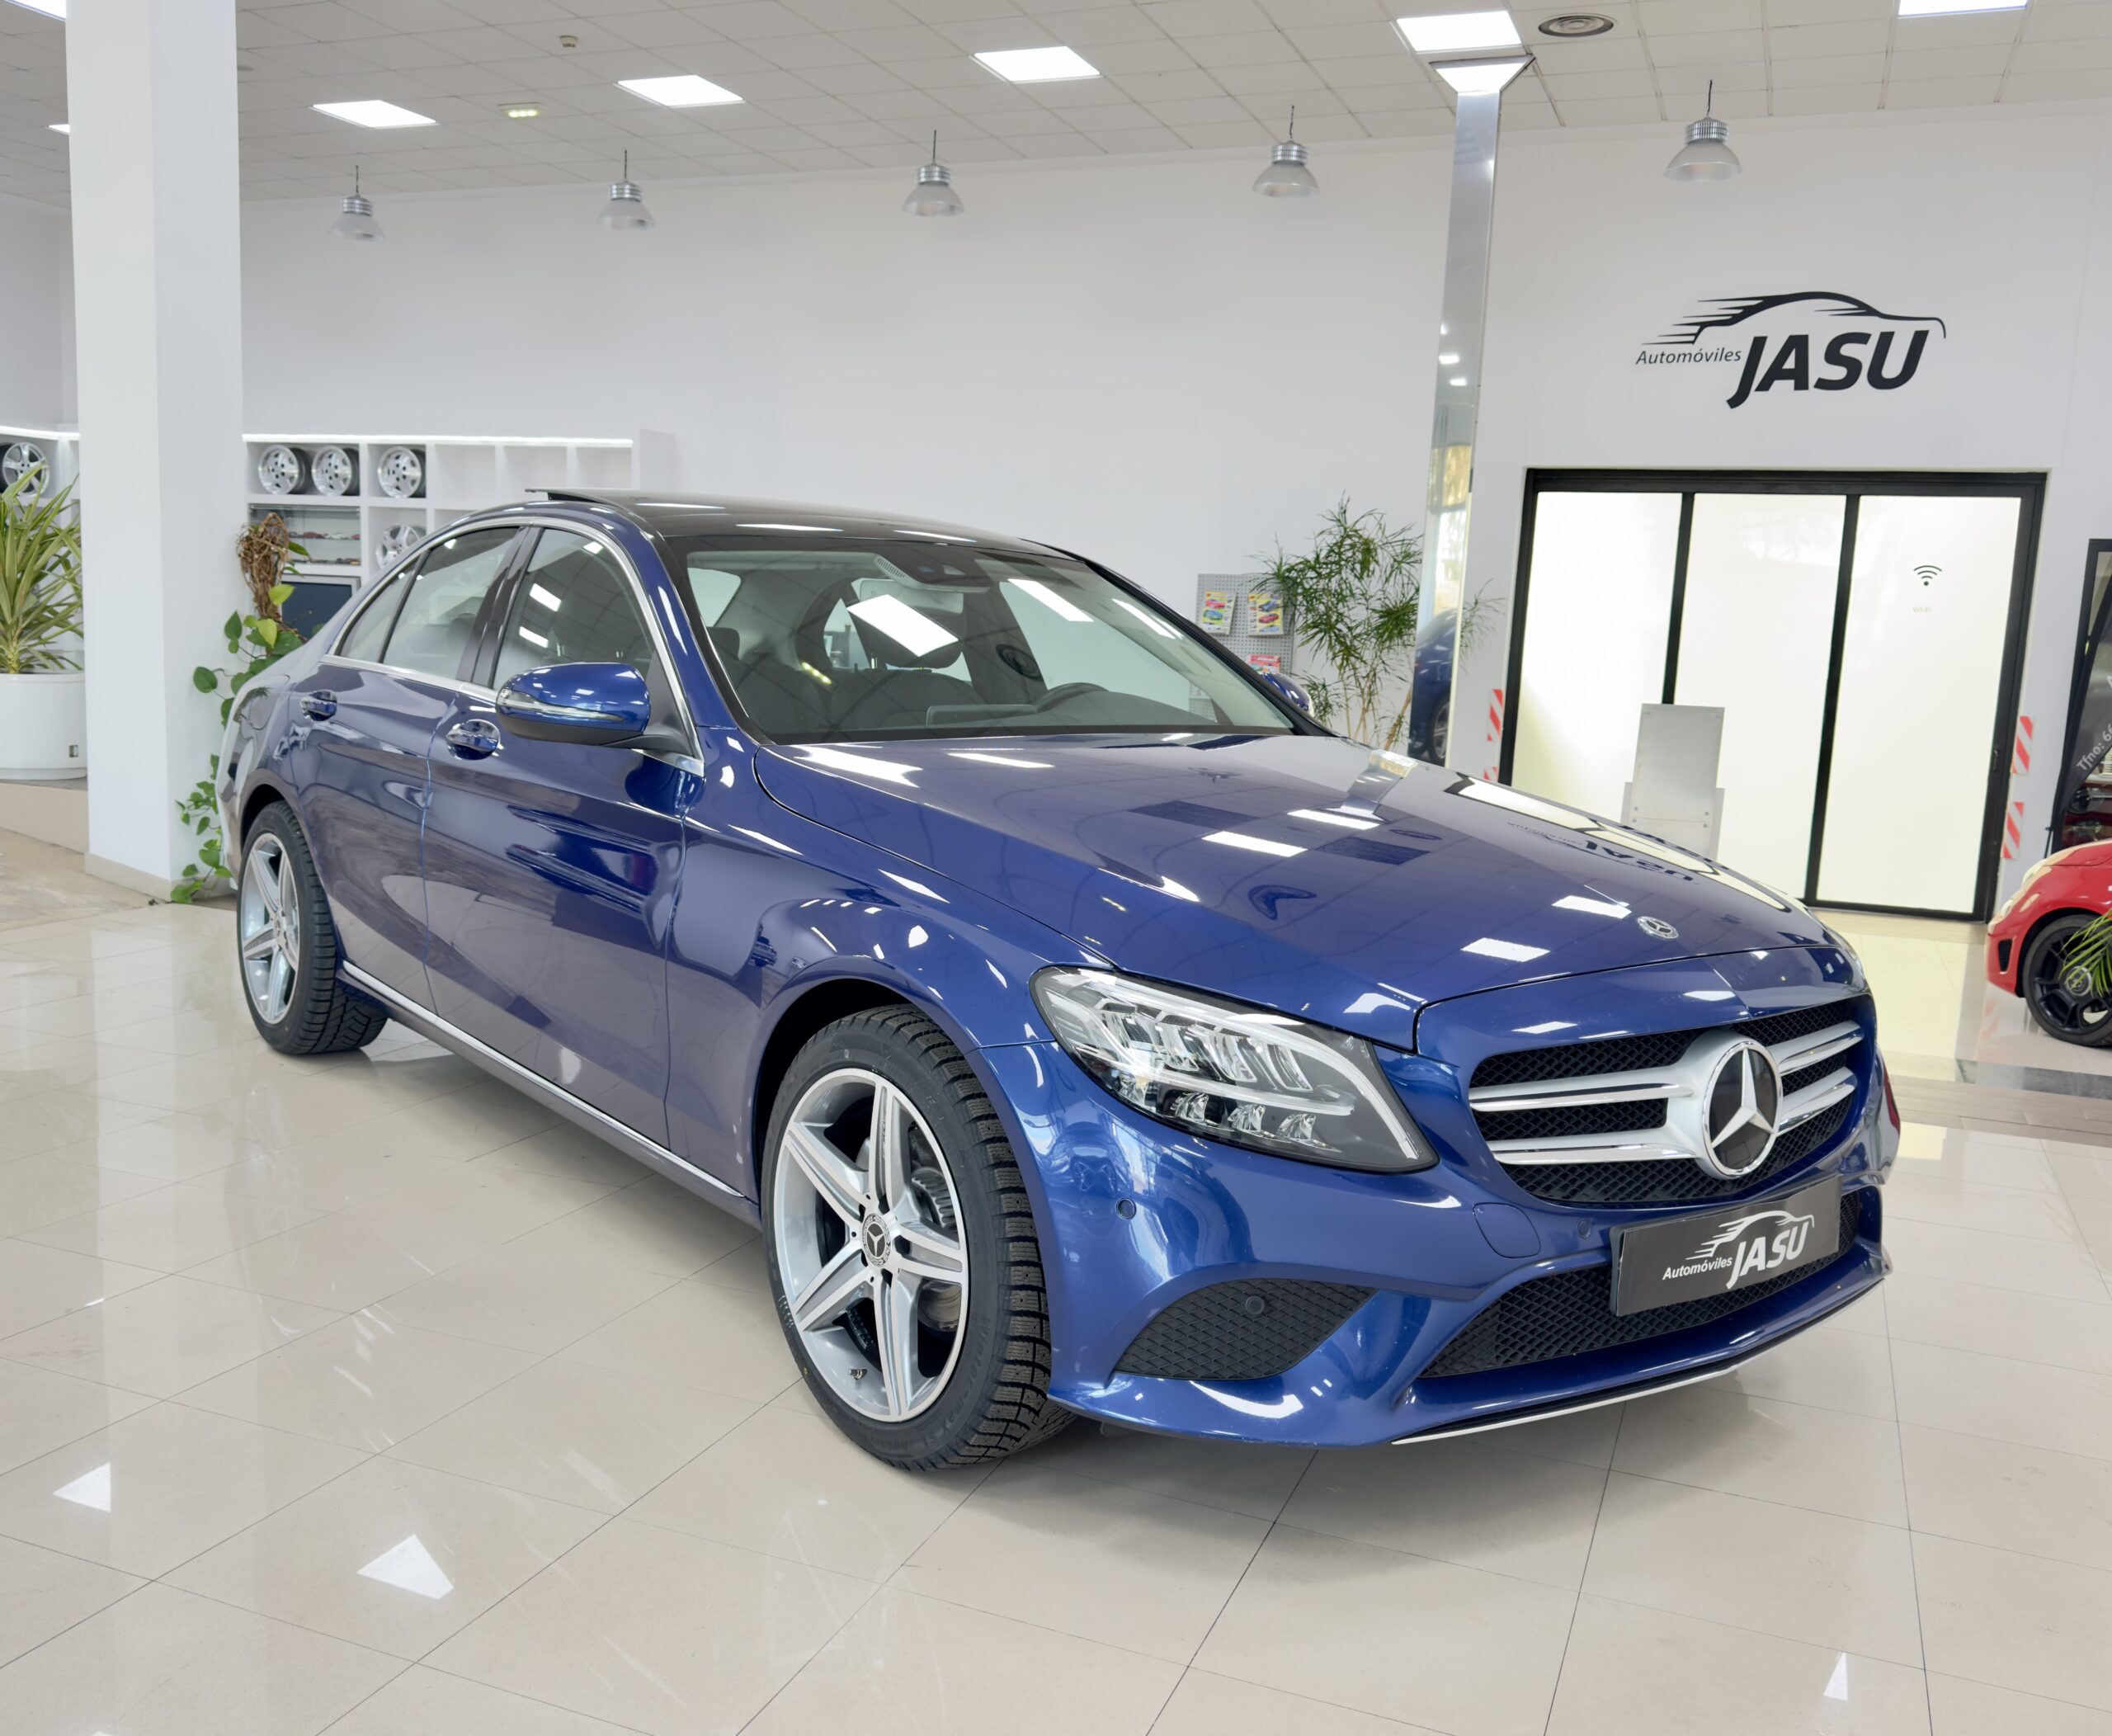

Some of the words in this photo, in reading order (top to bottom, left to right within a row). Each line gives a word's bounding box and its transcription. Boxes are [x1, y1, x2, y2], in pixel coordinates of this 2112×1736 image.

[1636, 347, 1742, 365] Automóviles
[1726, 329, 1930, 409] JASU
[2076, 742, 2105, 771] Tfno:
[1662, 1256, 1732, 1280] Automóviles
[1726, 1220, 1809, 1290] JASU
